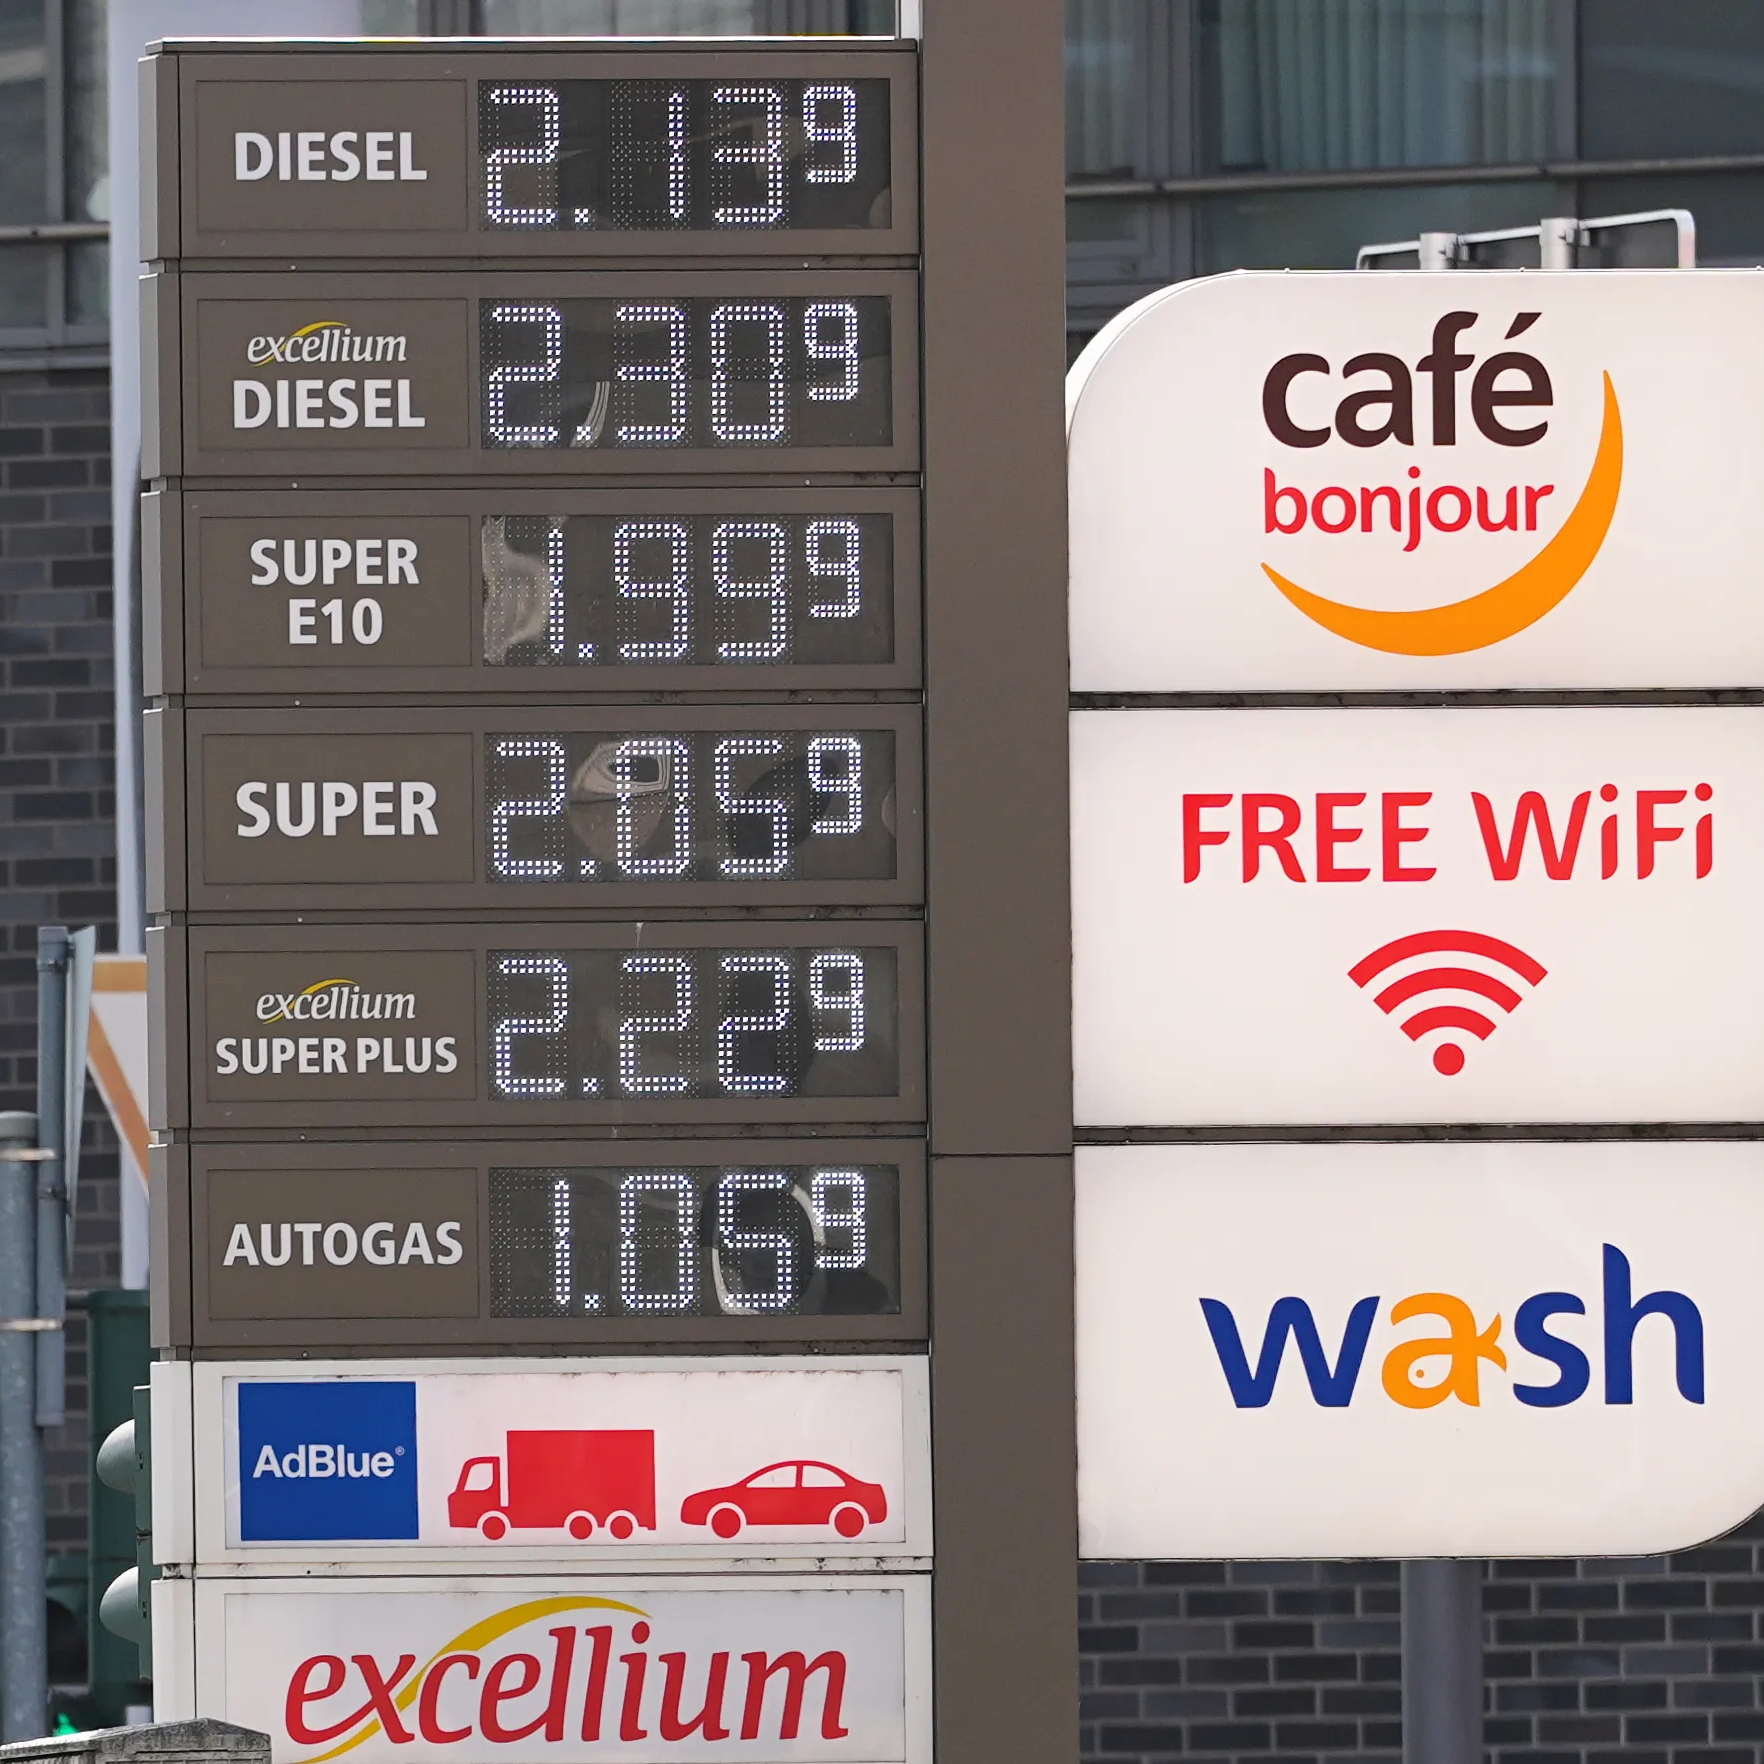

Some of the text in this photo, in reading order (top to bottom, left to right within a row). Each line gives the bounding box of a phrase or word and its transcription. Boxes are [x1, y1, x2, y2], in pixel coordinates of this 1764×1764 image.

[236, 132, 427, 180] DIESEL
[247, 323, 406, 363] excellium
[234, 379, 425, 428] DIESEL
[1263, 311, 1554, 448] café
[1263, 466, 1554, 552] bonjour
[250, 540, 419, 585] SUPER
[289, 598, 383, 645] E10
[236, 782, 438, 836] SUPER
[1183, 783, 1713, 884] FREE WiFi
[256, 980, 415, 1022] excellium
[216, 1037, 457, 1073] SUPER PLUS
[222, 1222, 463, 1266] AUTOGAS
[1199, 1243, 1704, 1409] wash
[285, 1622, 848, 1744] excellium
